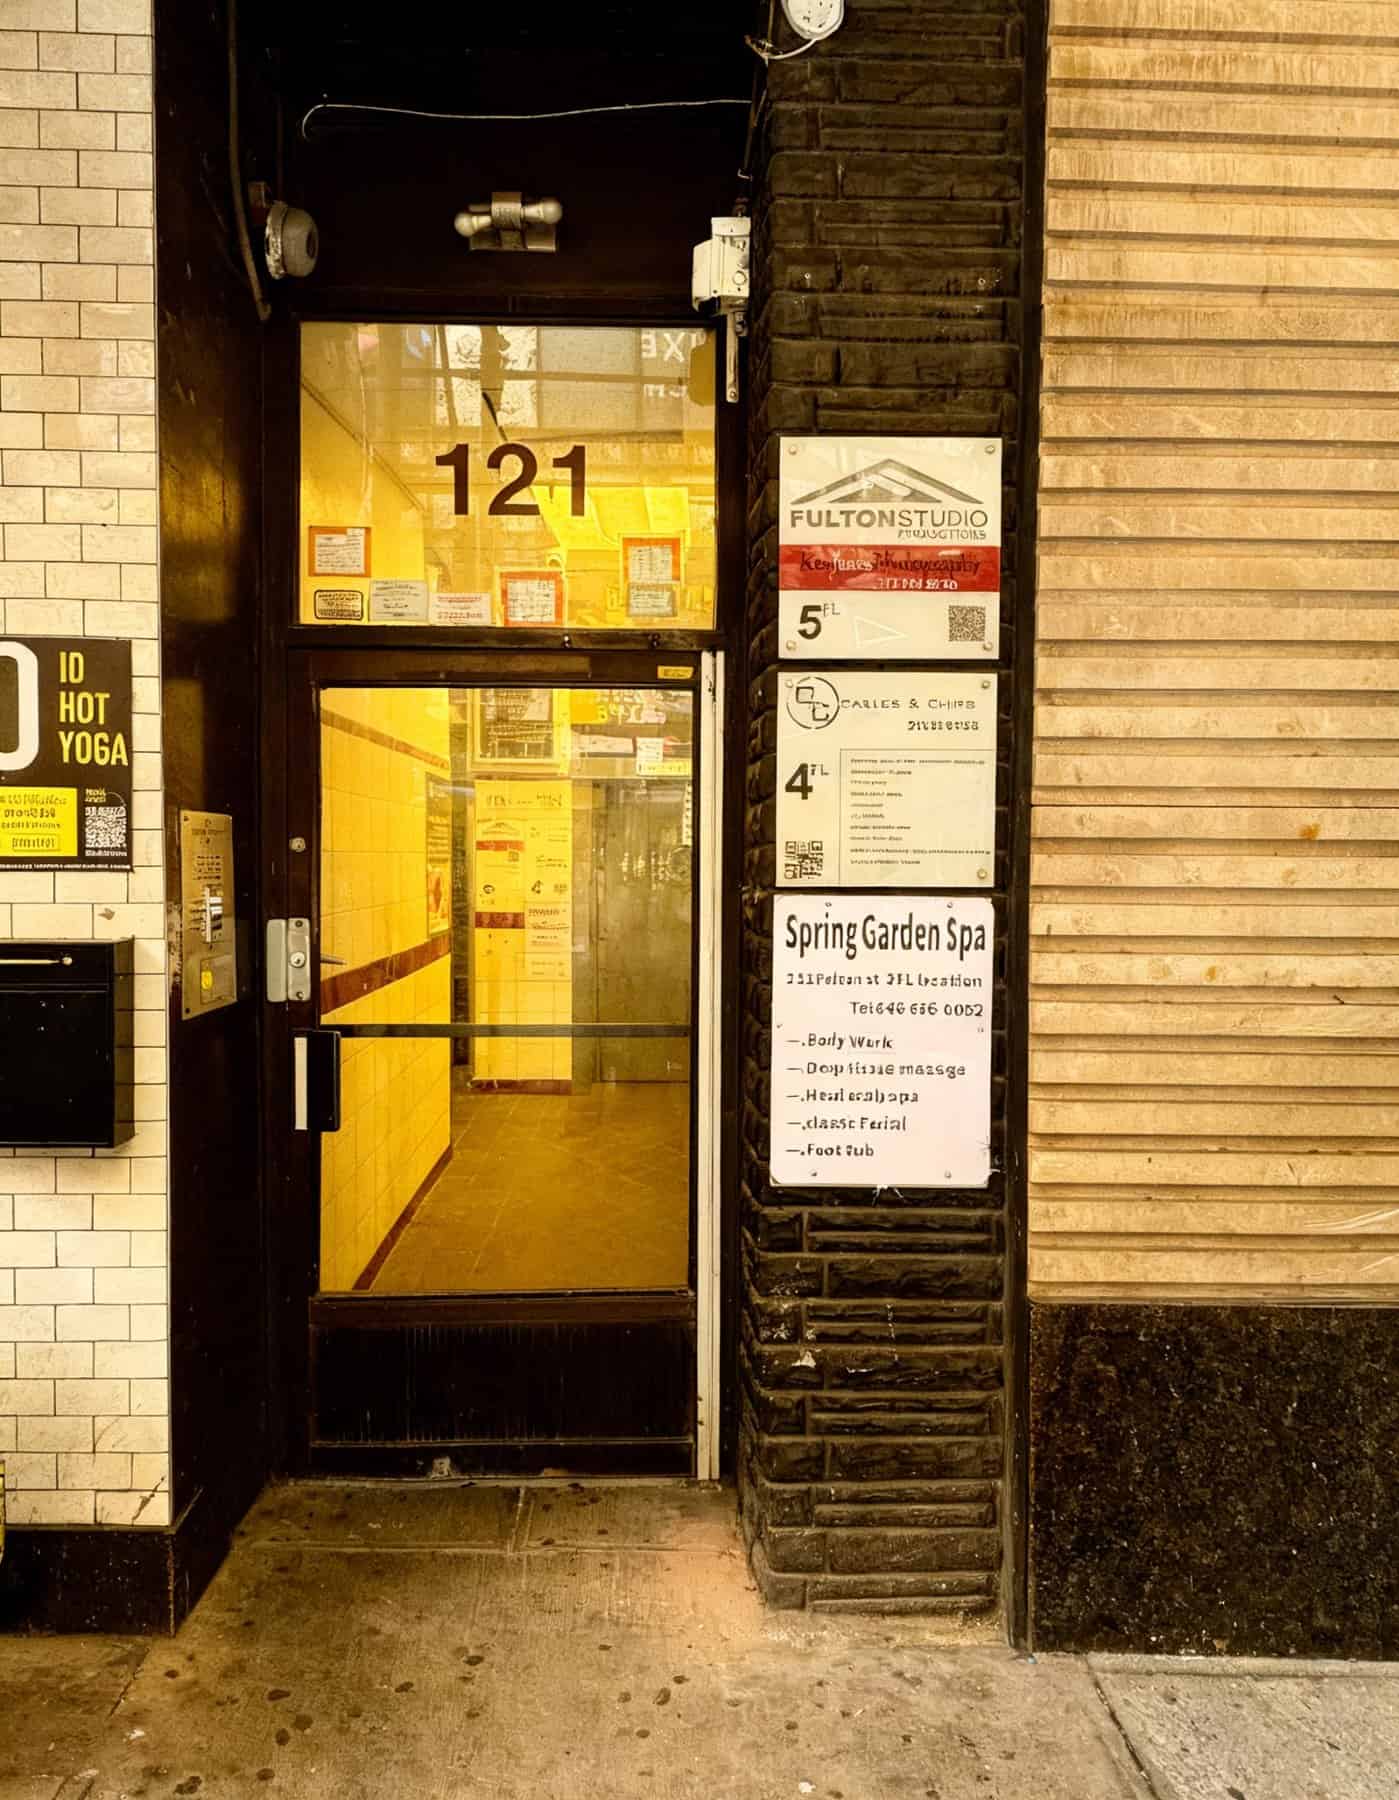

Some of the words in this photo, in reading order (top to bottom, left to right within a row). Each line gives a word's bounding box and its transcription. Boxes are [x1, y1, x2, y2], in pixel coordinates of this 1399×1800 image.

[434, 443, 587, 517] 121
[798, 605, 822, 639] 5
[60, 691, 110, 724] HOT
[909, 699, 919, 708] &
[59, 731, 128, 766] YOGA
[785, 763, 814, 800] 4
[786, 912, 857, 960] Spring
[862, 913, 939, 951] Garden
[947, 917, 985, 961] Spa
